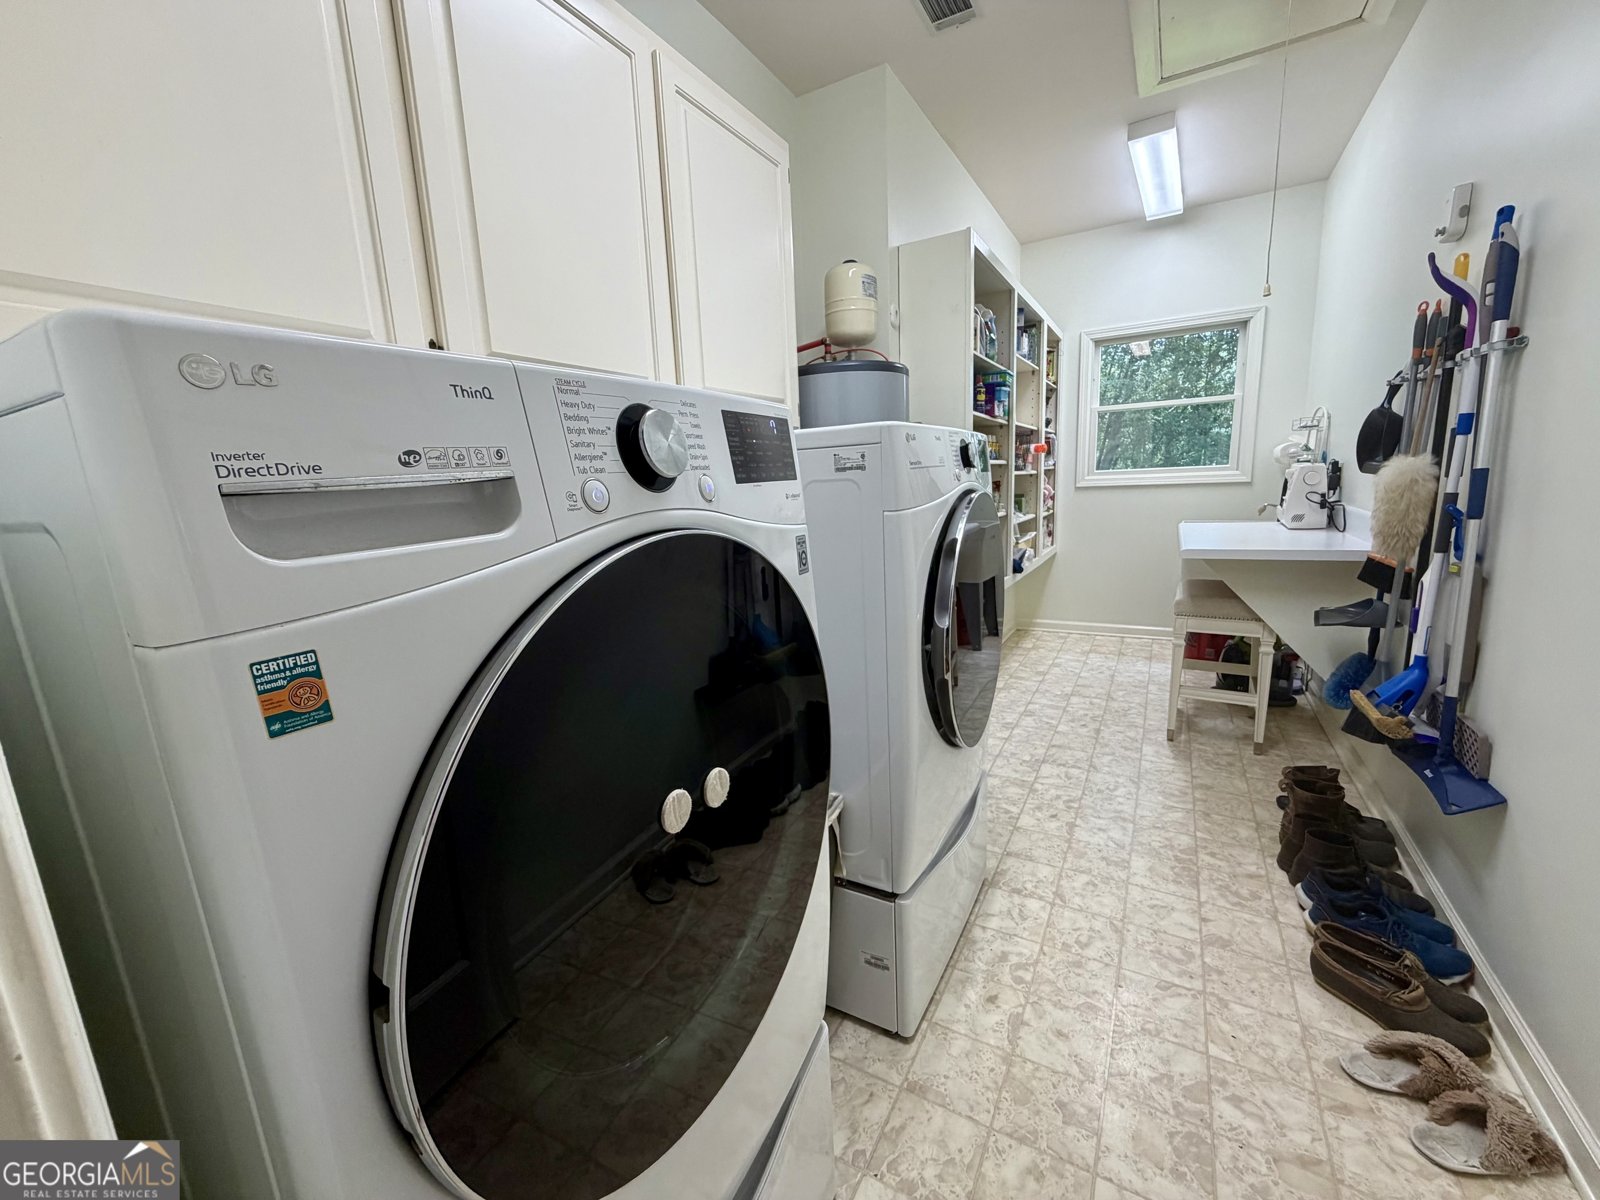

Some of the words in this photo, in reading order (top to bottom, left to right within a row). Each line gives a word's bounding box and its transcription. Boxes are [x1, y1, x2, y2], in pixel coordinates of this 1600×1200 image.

[229, 361, 279, 387] LG
[555, 378, 571, 387] STEAM
[572, 380, 587, 388] CYCLE
[449, 383, 494, 400] ThinQ
[557, 386, 581, 396] Normal
[560, 400, 580, 411] Heavy
[580, 401, 596, 412] Duty
[563, 412, 590, 425] Bedding
[566, 426, 587, 437] Bright
[569, 439, 596, 450] Sanitary
[210, 451, 266, 462] Inverter
[214, 462, 322, 479] DirectDrive
[576, 466, 589, 475] Tub
[588, 465, 607, 474] Clean
[252, 652, 317, 676] CERTIFIED
[256, 671, 285, 684] asthma
[292, 664, 317, 675] allergy
